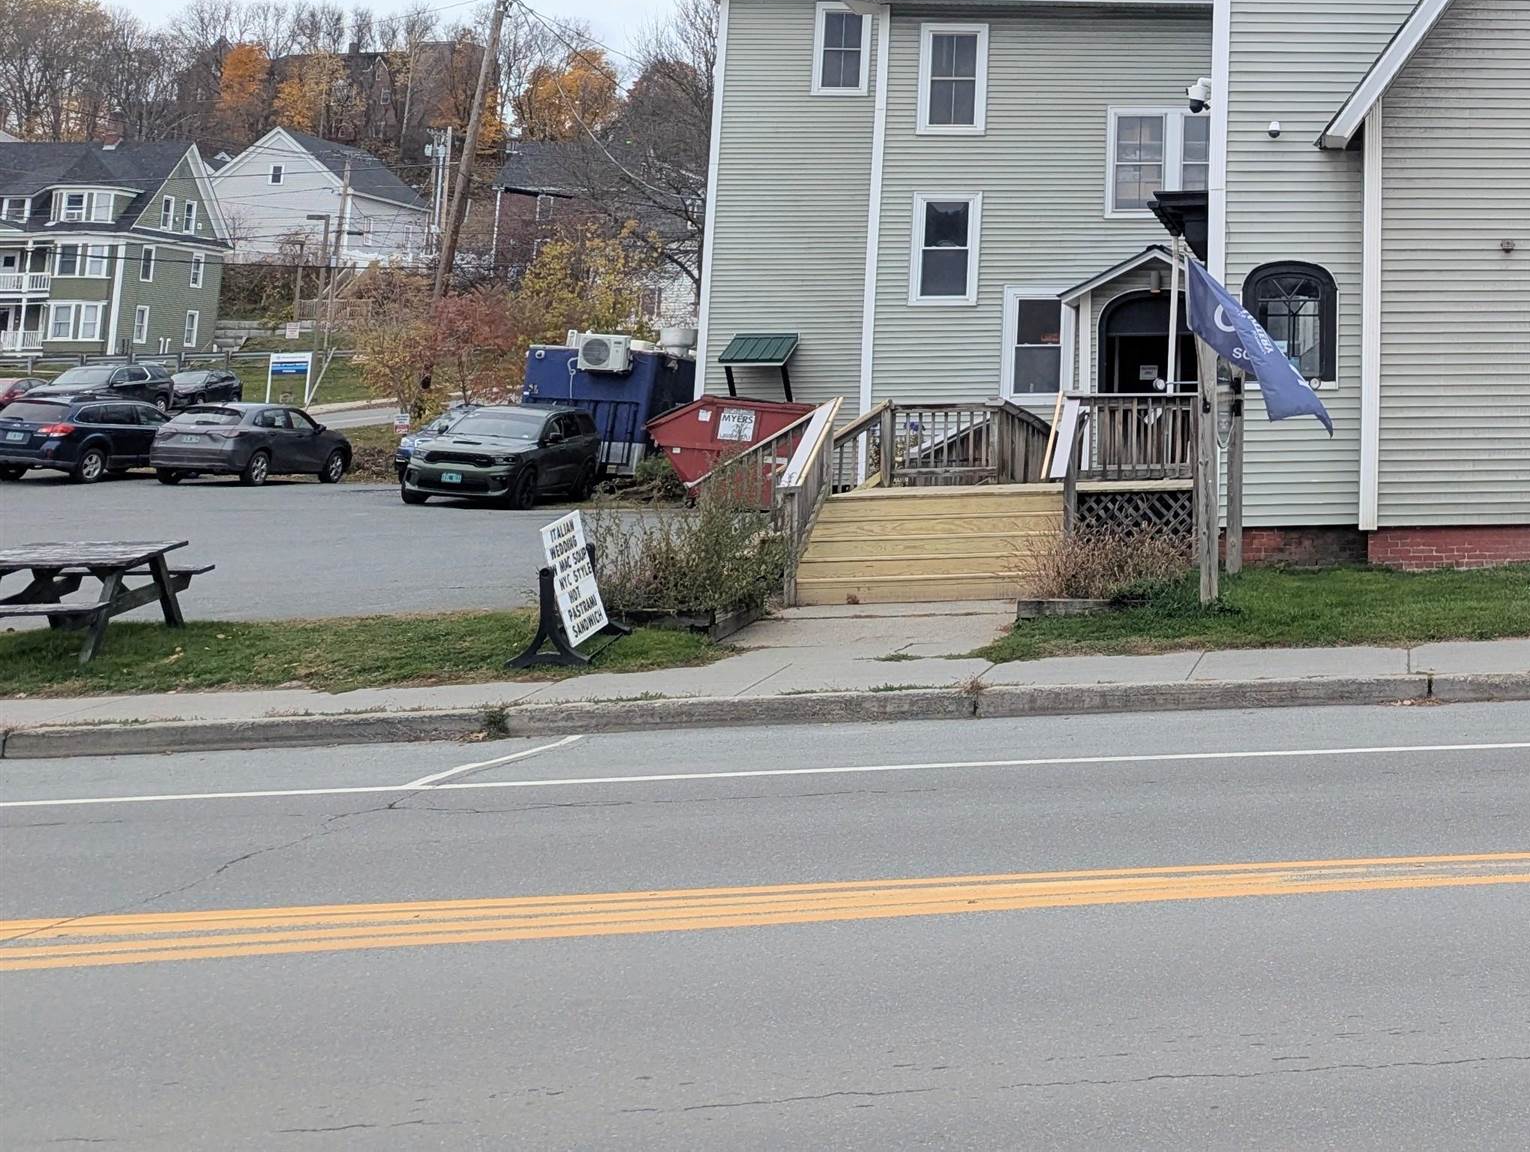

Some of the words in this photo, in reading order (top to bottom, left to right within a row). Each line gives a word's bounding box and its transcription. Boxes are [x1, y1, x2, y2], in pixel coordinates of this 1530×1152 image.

[722, 414, 753, 424] MYERS
[549, 518, 575, 543] ITALIAN
[550, 534, 577, 560] WEDDING
[559, 556, 572, 573] MAC
[572, 547, 587, 565] SOUP
[559, 573, 572, 591] NYC
[573, 562, 592, 583] STYLE
[567, 587, 581, 603] HOT
[567, 593, 598, 622] PASTRAMI
[572, 609, 603, 638] SANDWICH
